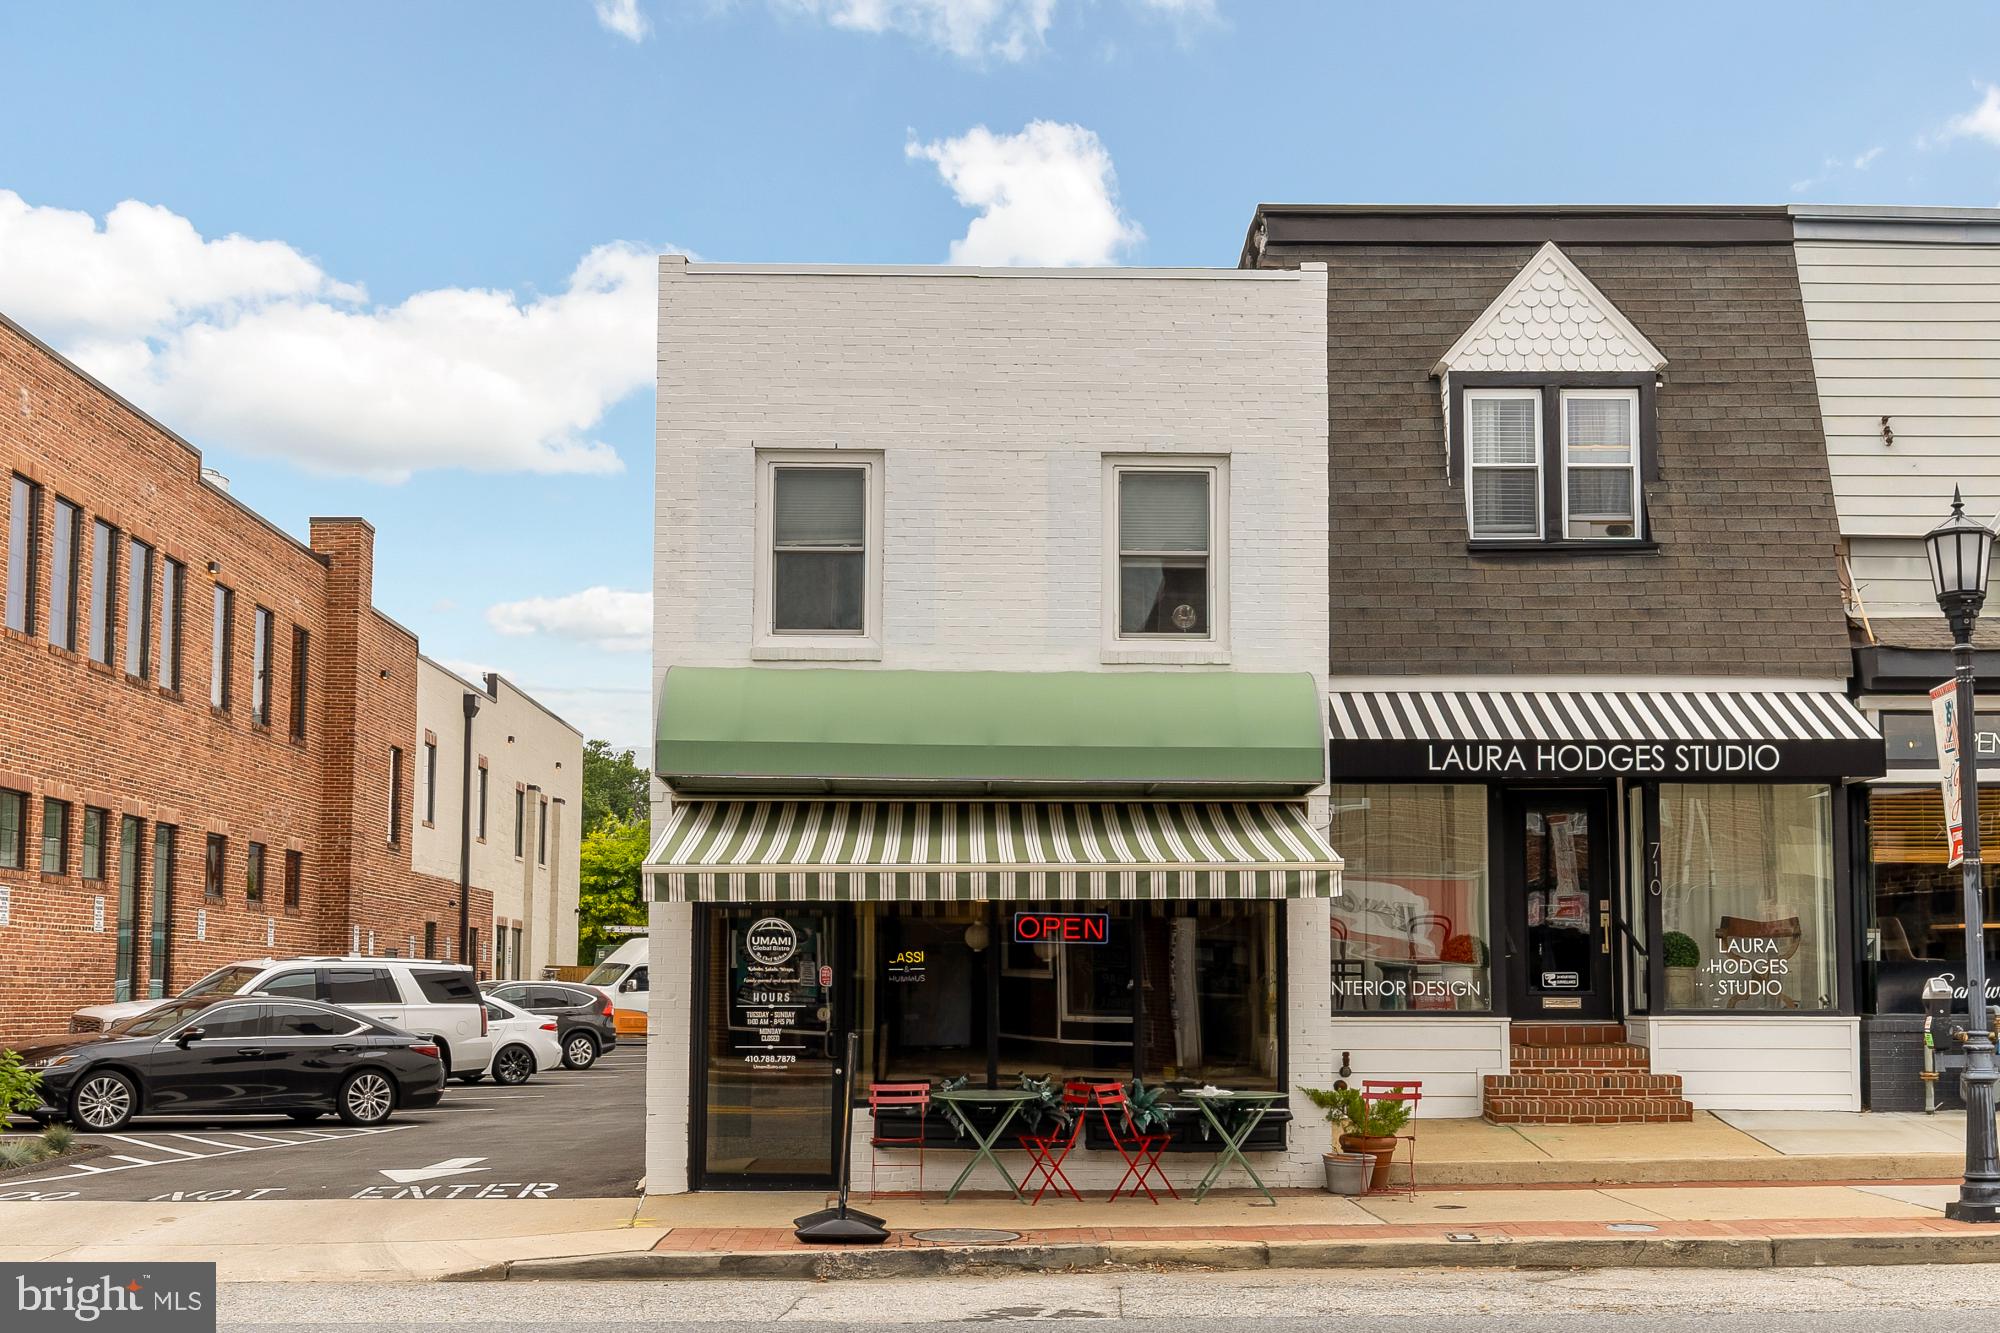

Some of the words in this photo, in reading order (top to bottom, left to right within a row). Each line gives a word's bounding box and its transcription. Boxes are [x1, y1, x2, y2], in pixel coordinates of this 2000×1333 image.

[1428, 744, 1527, 772] LAURA
[1537, 744, 1666, 772] HODGES
[1674, 744, 1780, 772] STUDIO
[1649, 842, 1662, 896] 710
[1018, 916, 1104, 940] OPEN
[751, 936, 792, 946] UMAMI
[1718, 938, 1779, 954] LAURA
[888, 950, 925, 964] ASSI
[1710, 958, 1789, 975] HODGES
[1330, 980, 1407, 996] NTERIOR
[1413, 980, 1481, 996] DESIGN
[1718, 979, 1782, 996] STUDIO
[753, 992, 790, 1002] HOURS
[744, 1055, 796, 1063] 410.788.7878
[350, 1182, 559, 1200] ENTER
